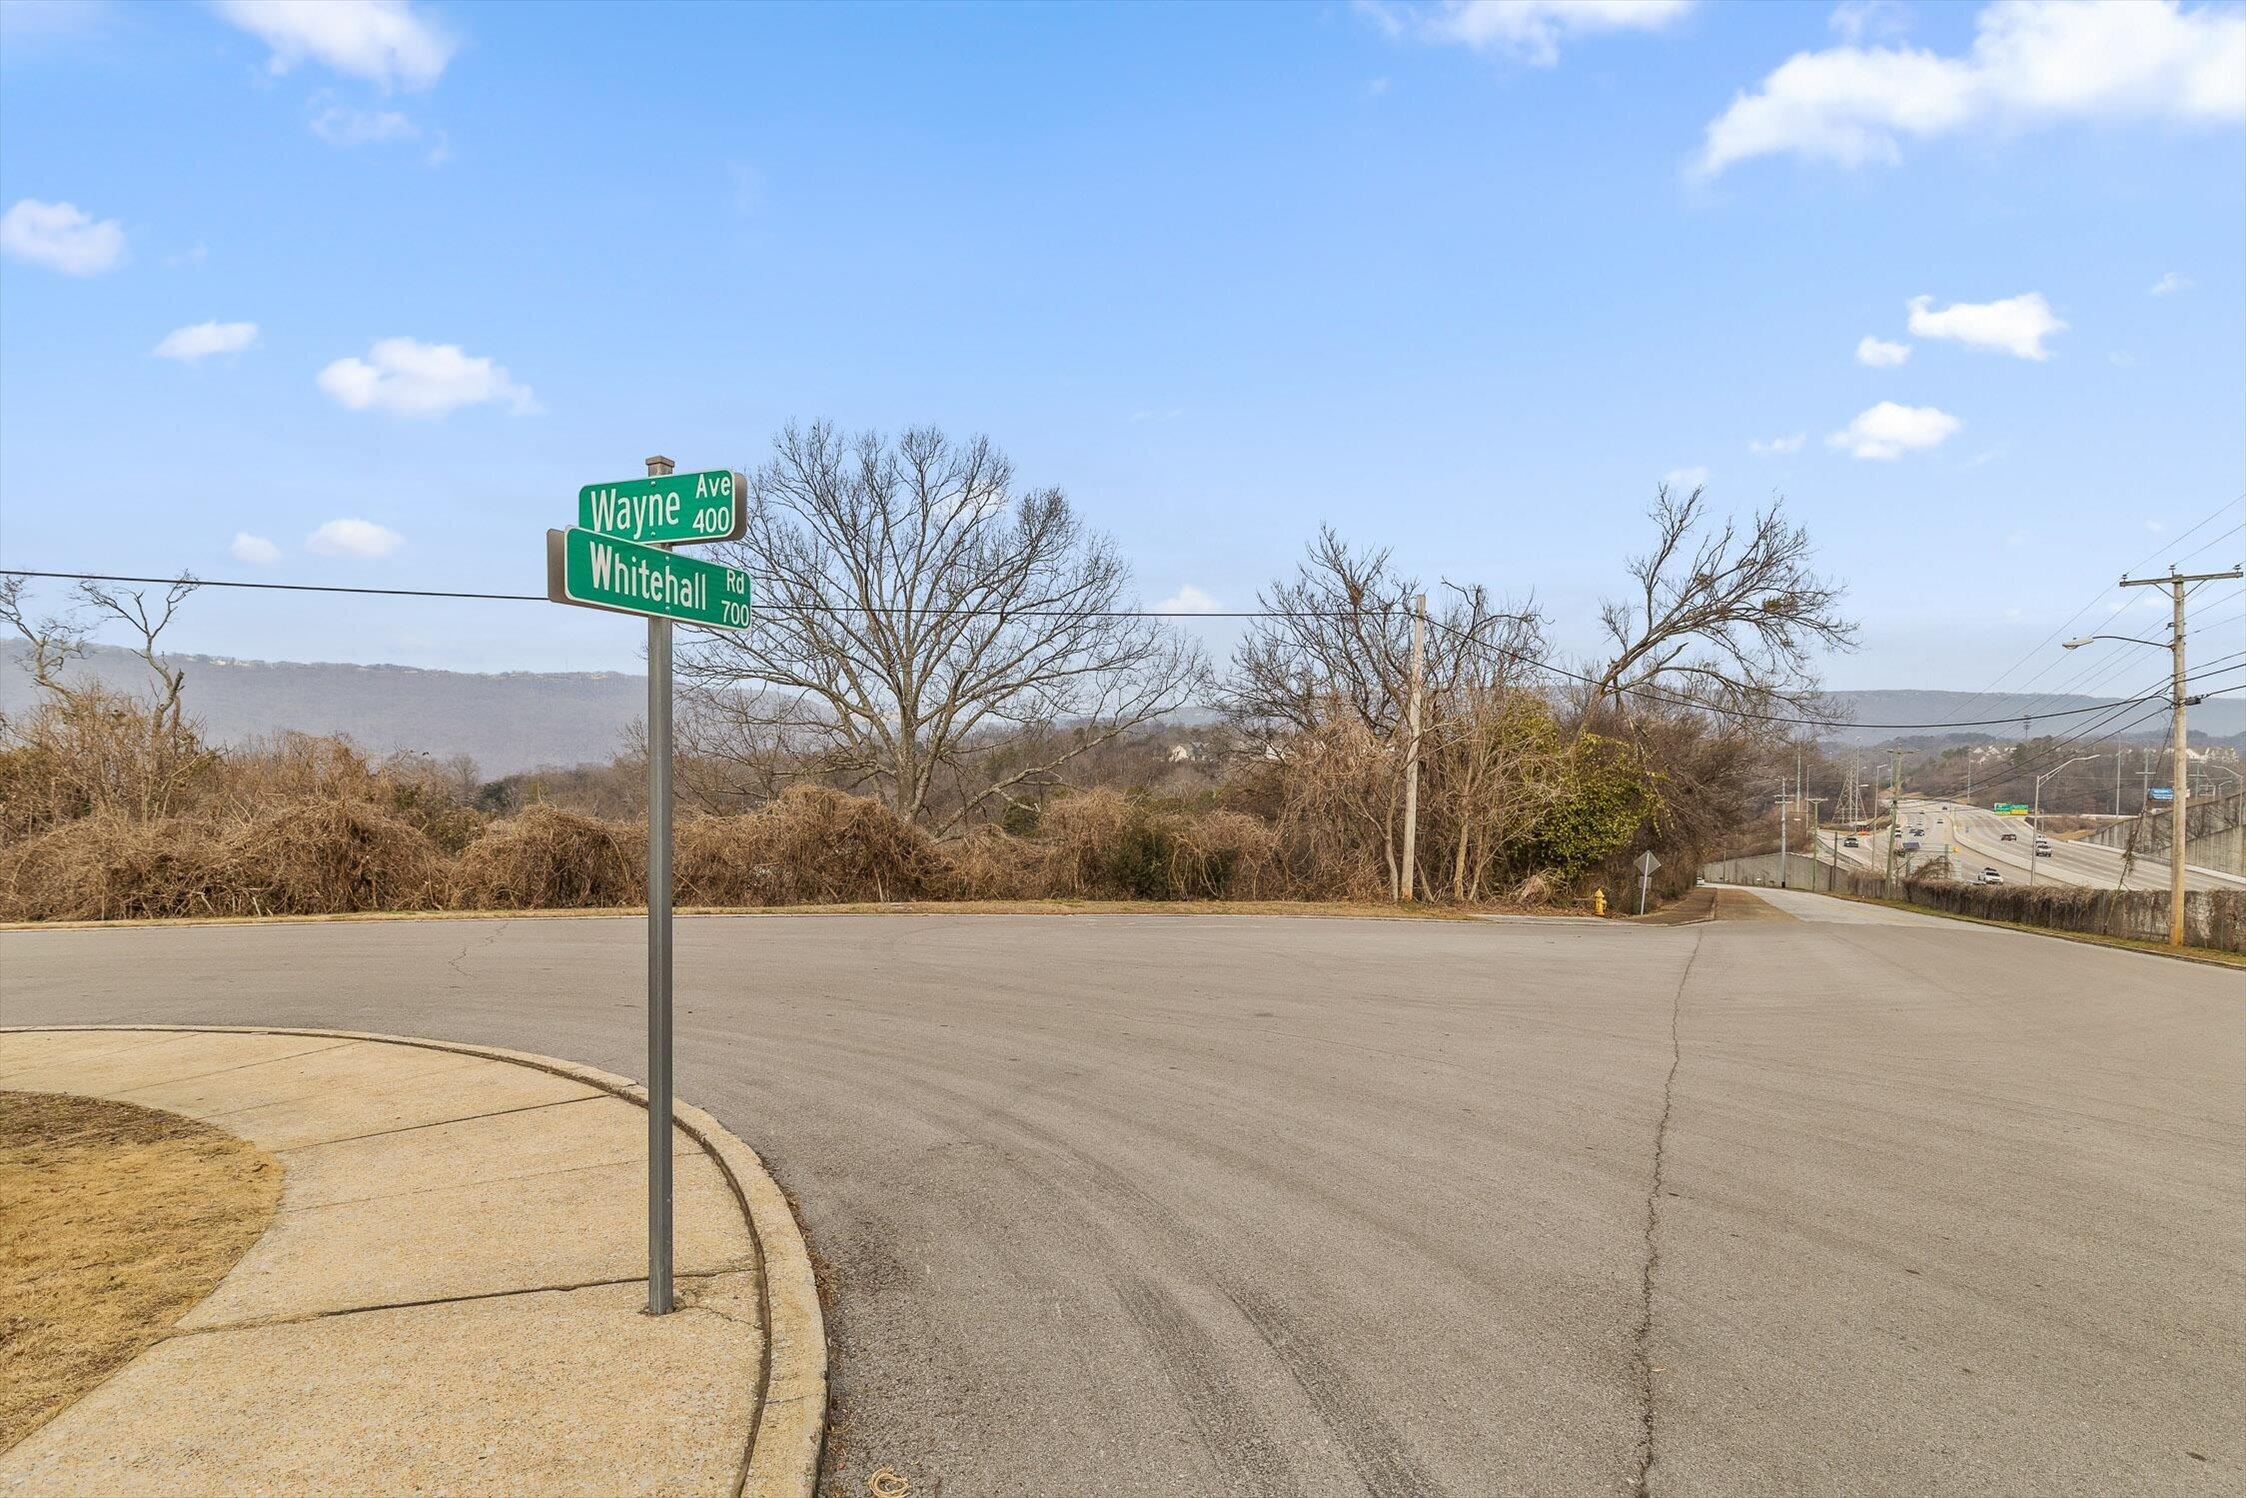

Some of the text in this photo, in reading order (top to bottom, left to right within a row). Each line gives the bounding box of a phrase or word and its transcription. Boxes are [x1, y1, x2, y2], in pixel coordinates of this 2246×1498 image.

[590, 473, 731, 540] Wayne Ave
[692, 506, 730, 534] 400
[589, 540, 744, 611] Whitehall Rd
[721, 600, 749, 627] 700
